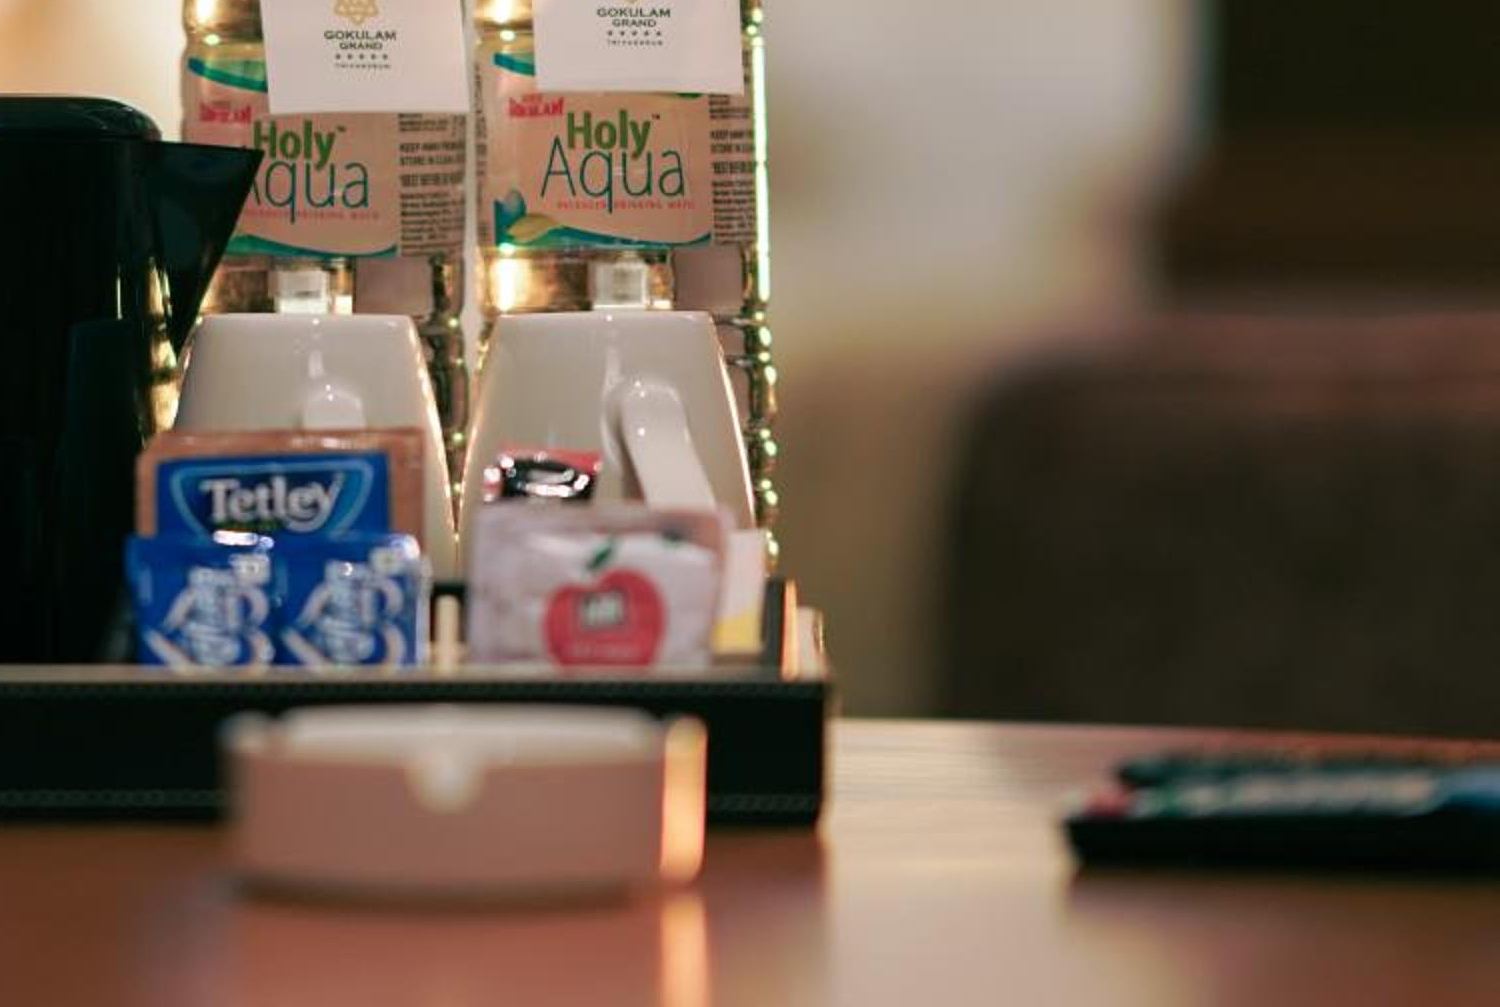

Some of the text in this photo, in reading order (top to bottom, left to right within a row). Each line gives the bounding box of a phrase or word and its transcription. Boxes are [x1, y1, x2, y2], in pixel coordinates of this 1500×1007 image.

[323, 30, 397, 41] GOKULAM
[596, 7, 671, 18] GOKULAM
[612, 18, 657, 28] GRAND
[339, 42, 383, 50] GRAND
[253, 120, 337, 171] Holy
[567, 109, 652, 160] Holy
[252, 160, 370, 224] qua
[540, 135, 685, 214] Aqua
[198, 470, 346, 533] Tetley
